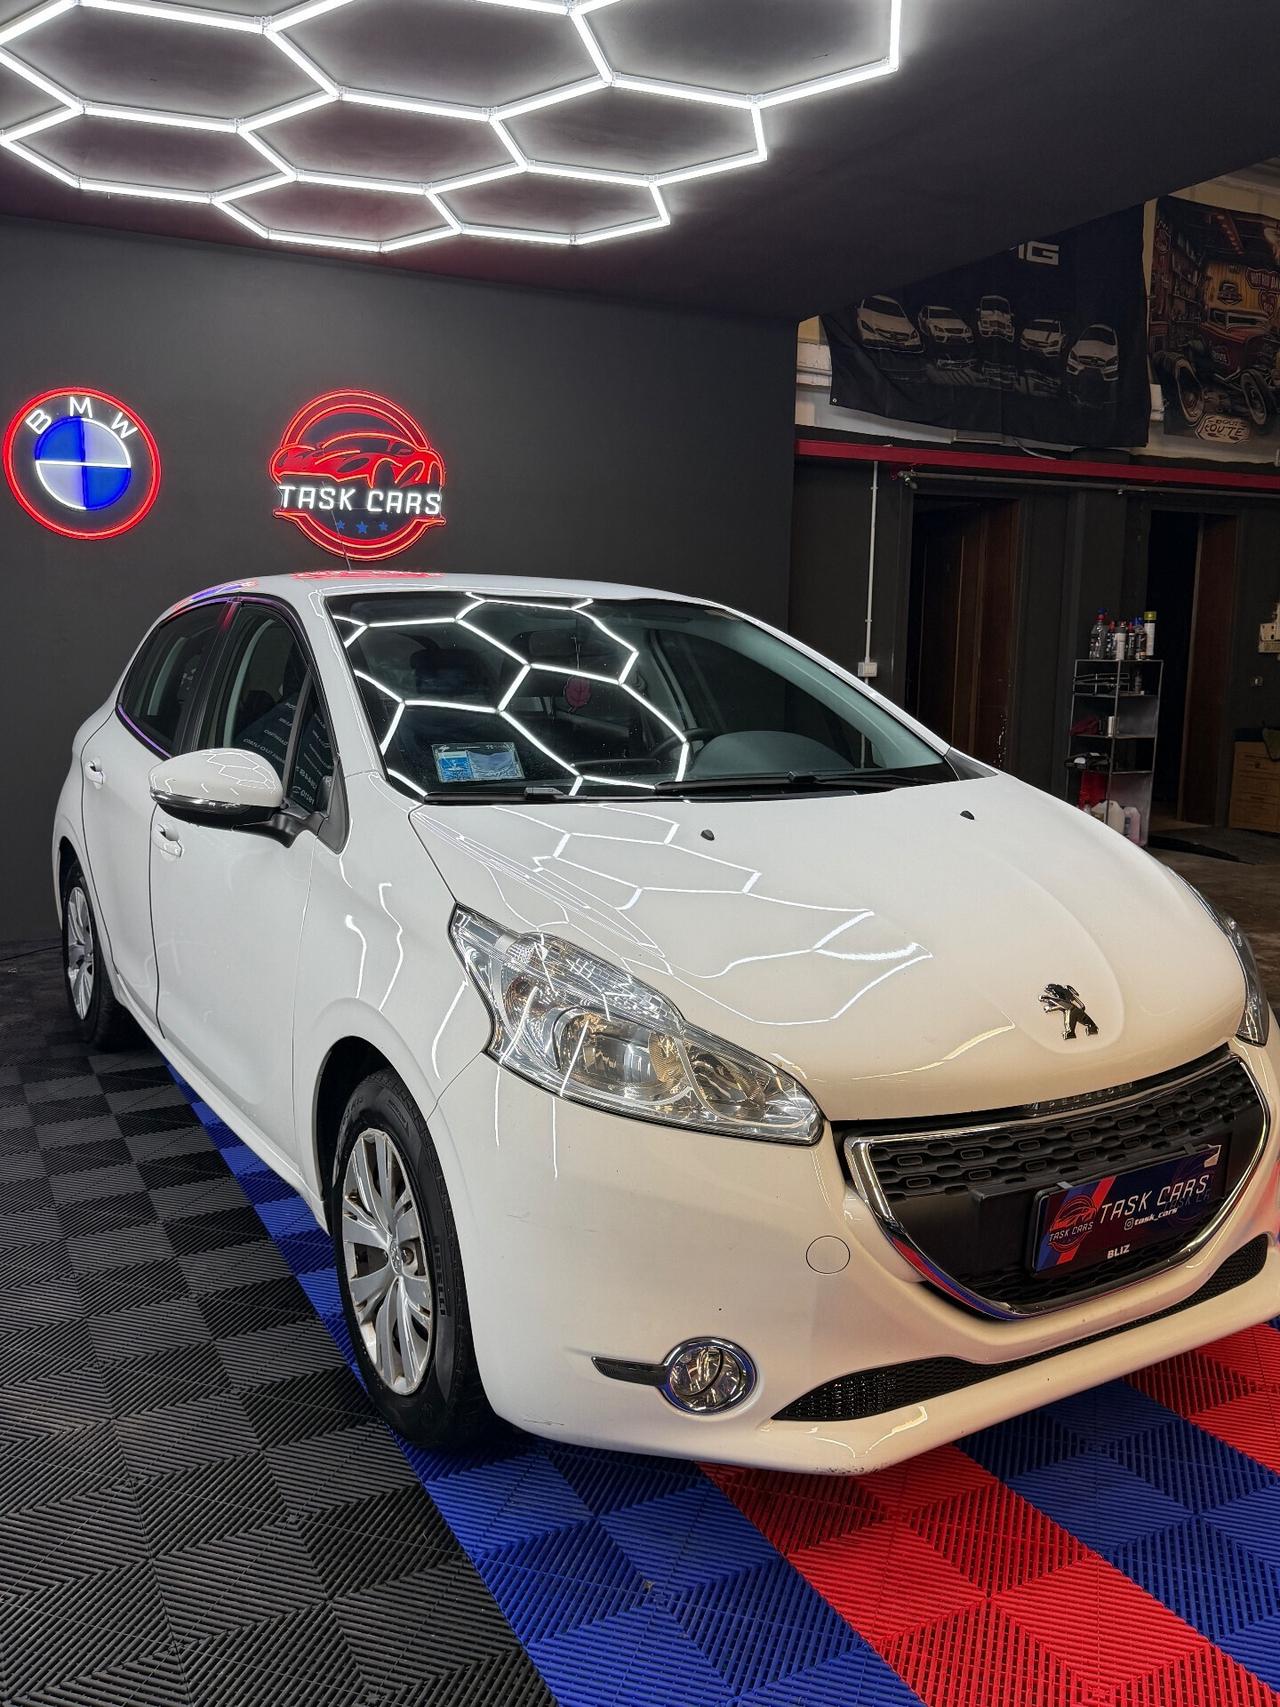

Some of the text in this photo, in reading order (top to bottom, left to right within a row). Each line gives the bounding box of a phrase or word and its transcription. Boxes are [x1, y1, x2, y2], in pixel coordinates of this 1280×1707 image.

[25, 396, 138, 439] BMW
[279, 485, 441, 515] TASK CARS
[1100, 1174, 1210, 1224] TASK CARS
[1049, 1221, 1094, 1242] TASK CARS
[1107, 1243, 1131, 1260] BLIZ
